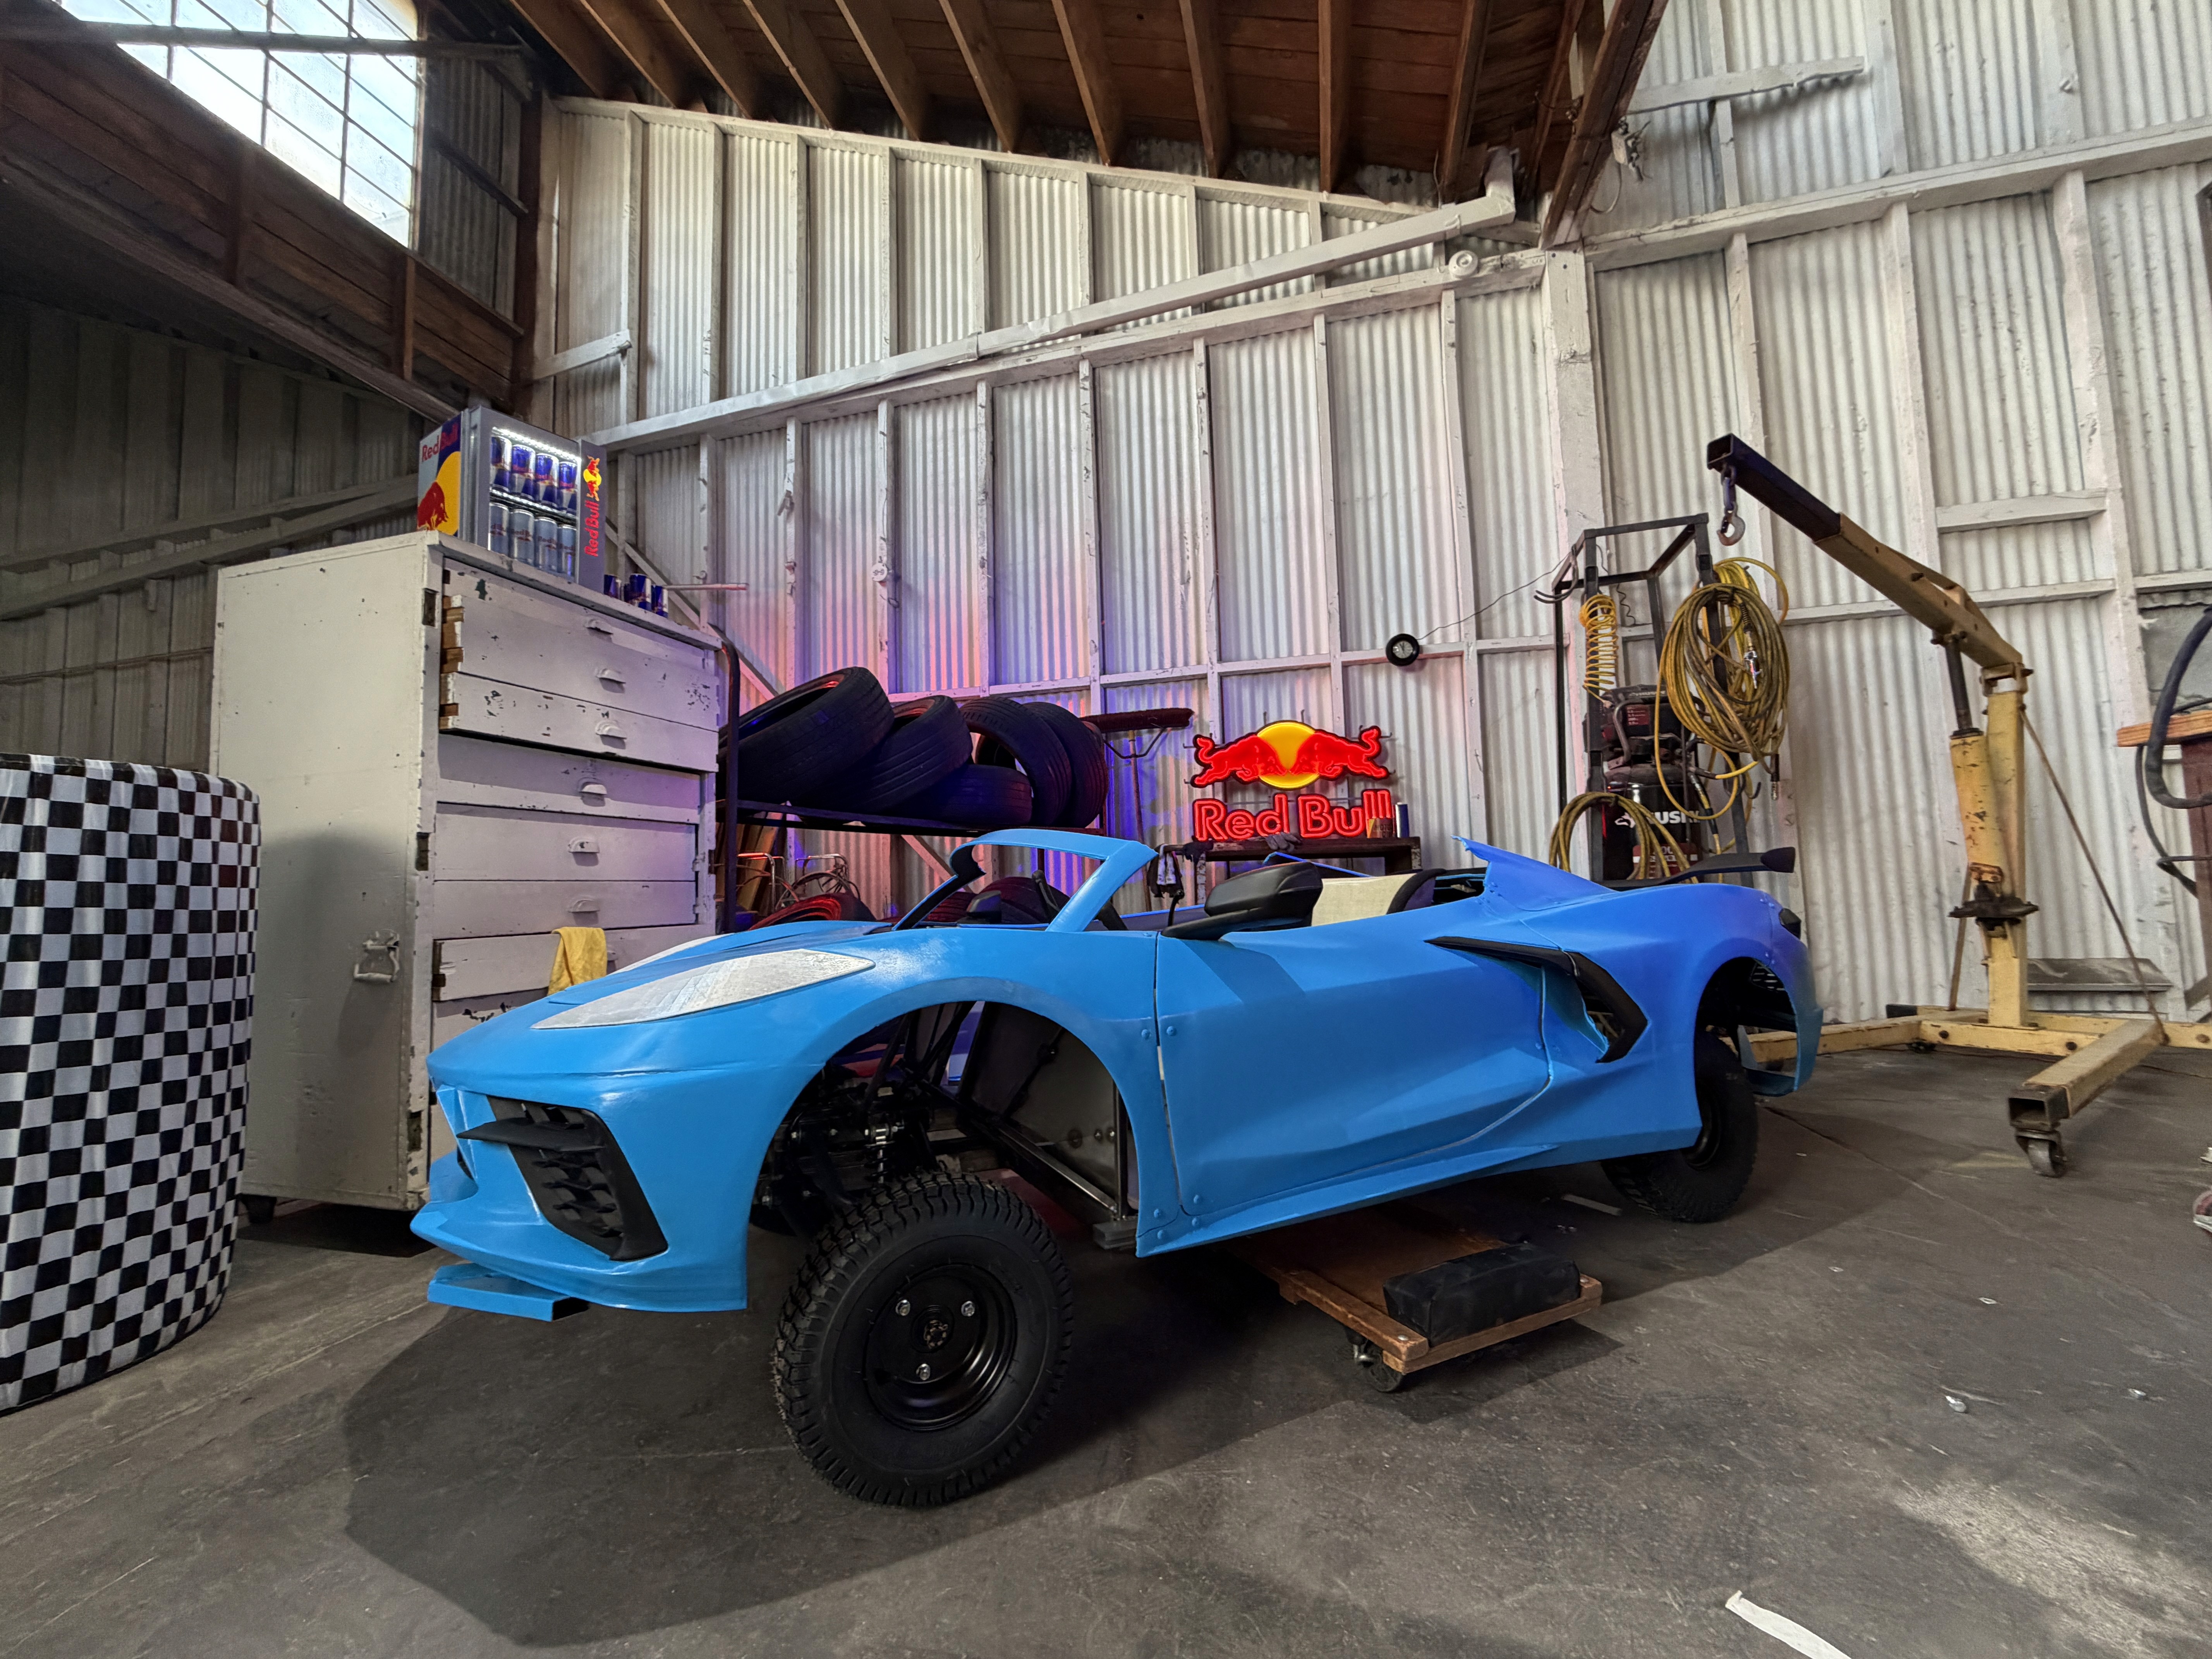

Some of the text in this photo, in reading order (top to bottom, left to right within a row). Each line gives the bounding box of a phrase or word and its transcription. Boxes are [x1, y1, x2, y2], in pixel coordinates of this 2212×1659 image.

[422, 422, 459, 462] Red Bull
[584, 500, 600, 557] Red Bull
[1194, 788, 1393, 841] Red Bull
